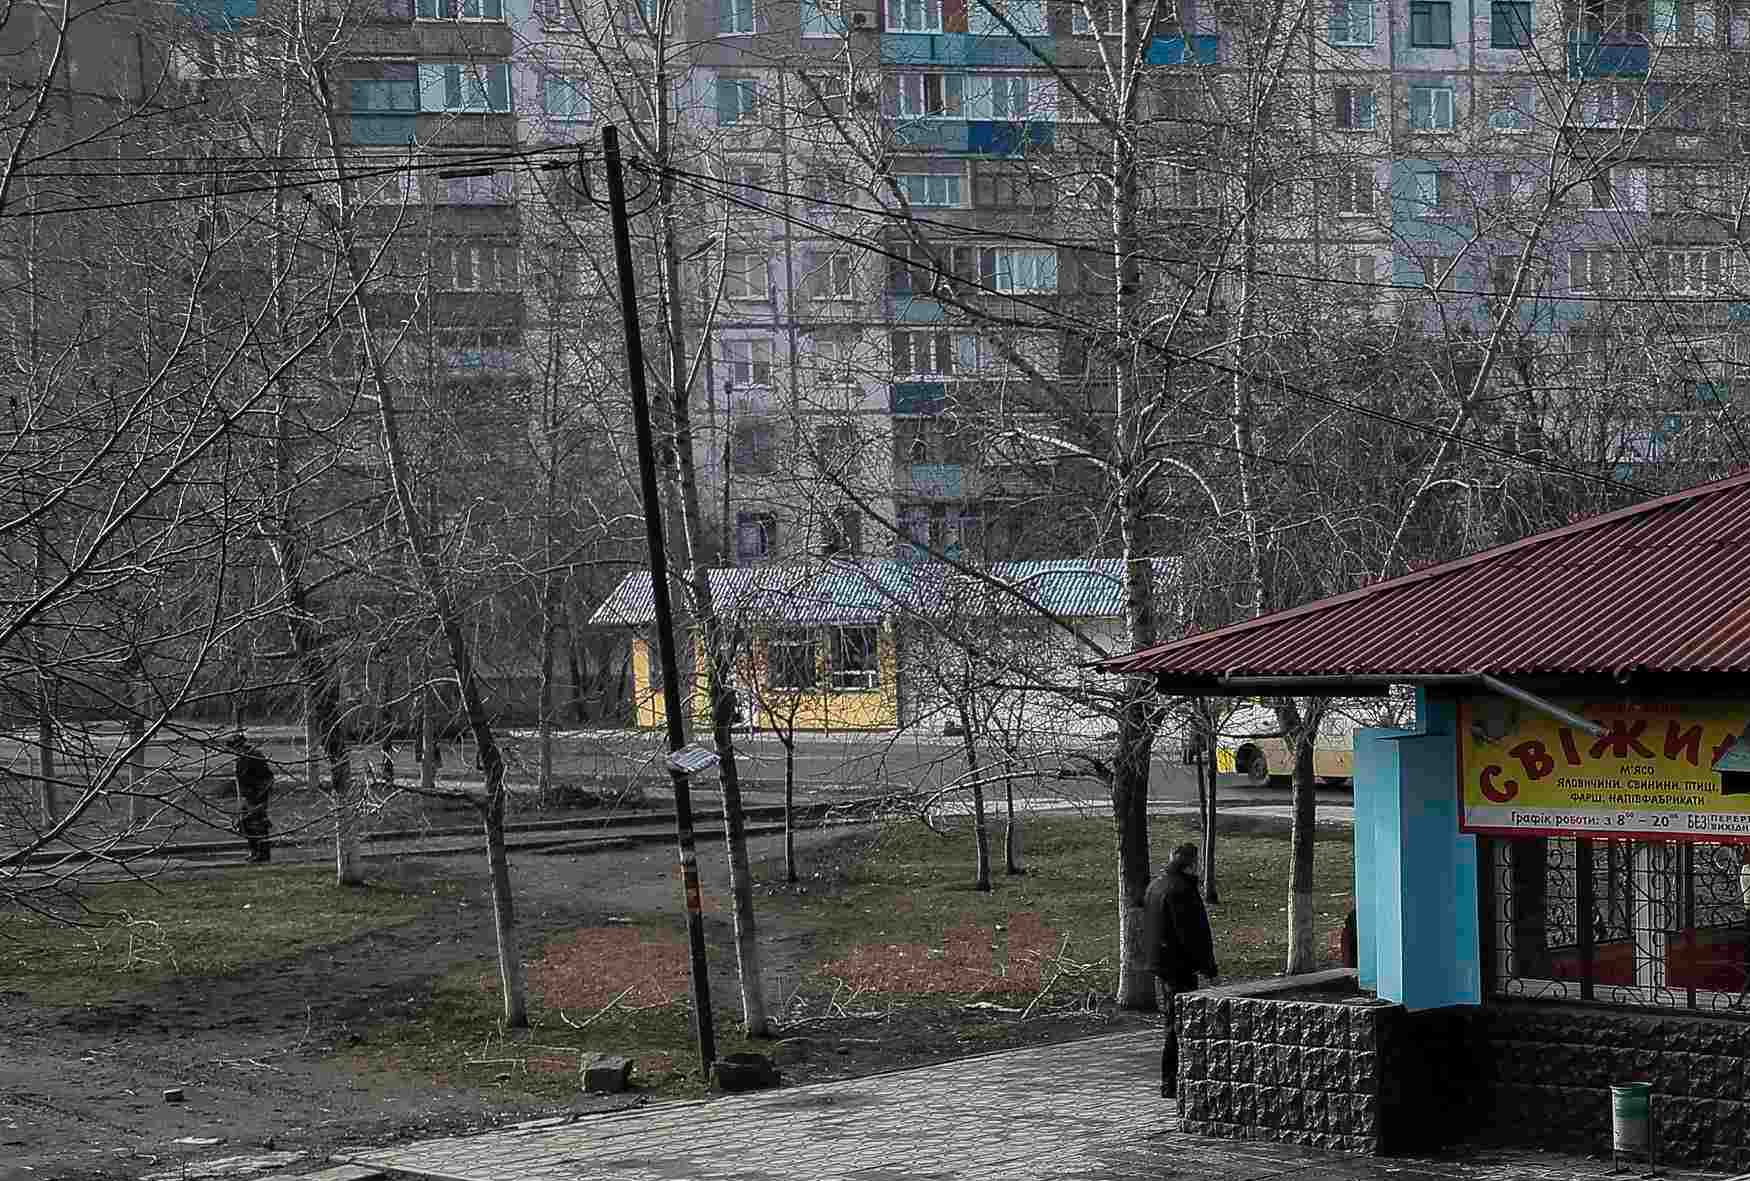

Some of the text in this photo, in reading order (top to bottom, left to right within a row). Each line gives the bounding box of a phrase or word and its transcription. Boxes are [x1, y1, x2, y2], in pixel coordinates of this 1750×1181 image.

[1511, 811, 1552, 826] Графік
[1555, 813, 1600, 827] роботи:
[1687, 814, 1707, 830] БЕЗ
